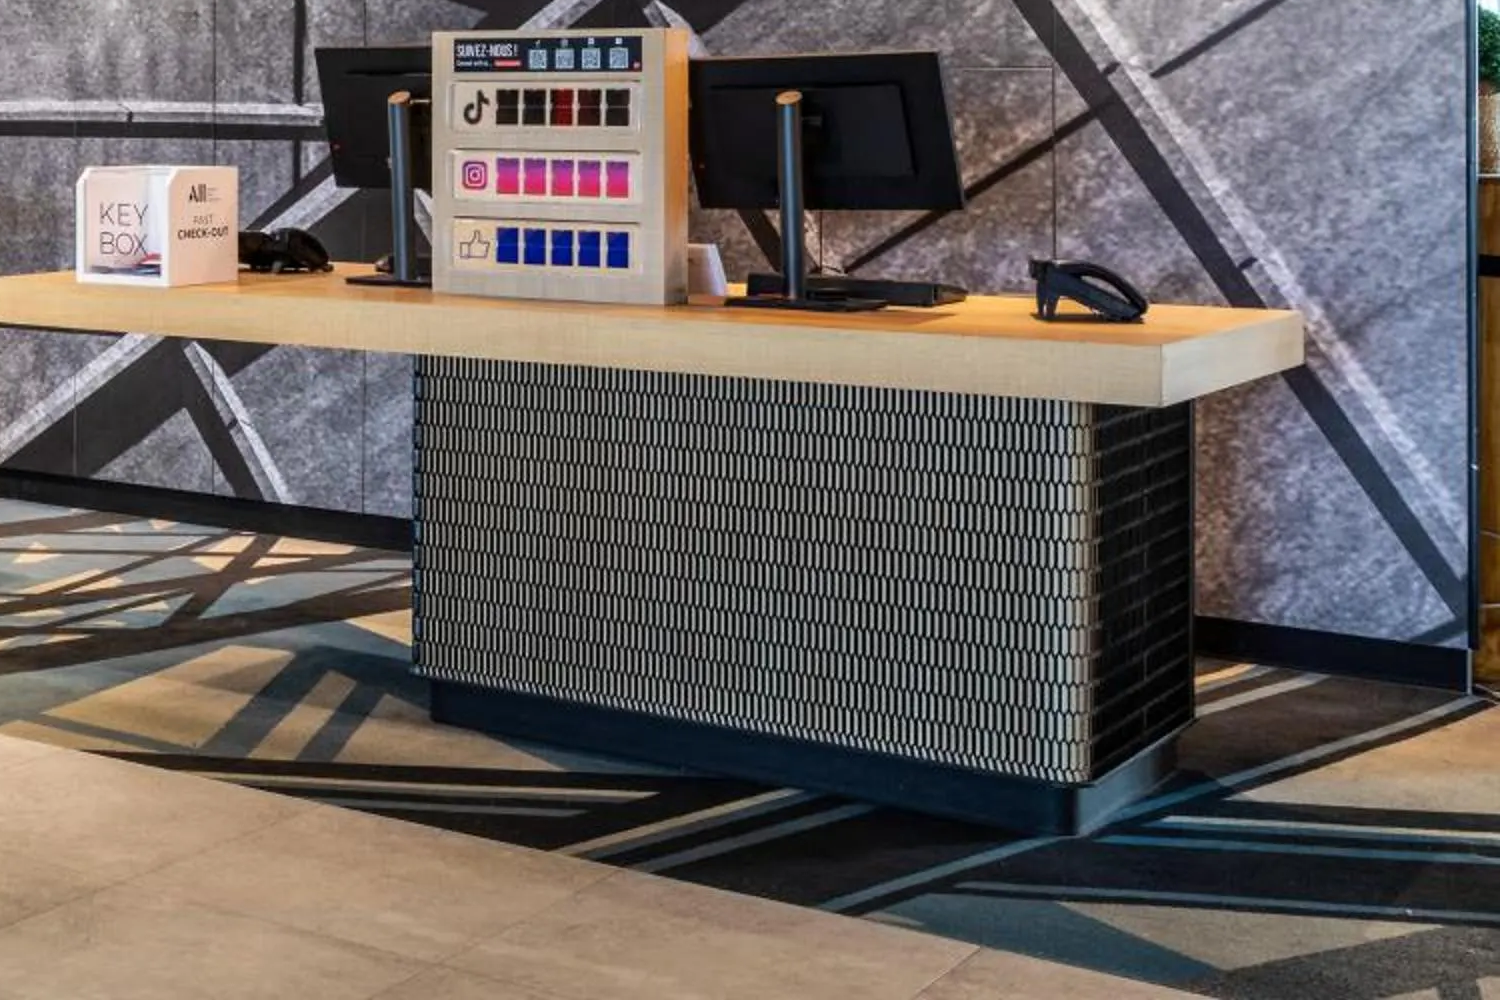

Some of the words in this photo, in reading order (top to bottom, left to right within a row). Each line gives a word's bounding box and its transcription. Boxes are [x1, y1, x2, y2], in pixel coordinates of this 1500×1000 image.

[189, 183, 207, 202] All
[99, 203, 149, 227] KEY
[99, 231, 149, 256] BOX
[177, 226, 229, 240] CHECK-OUT
